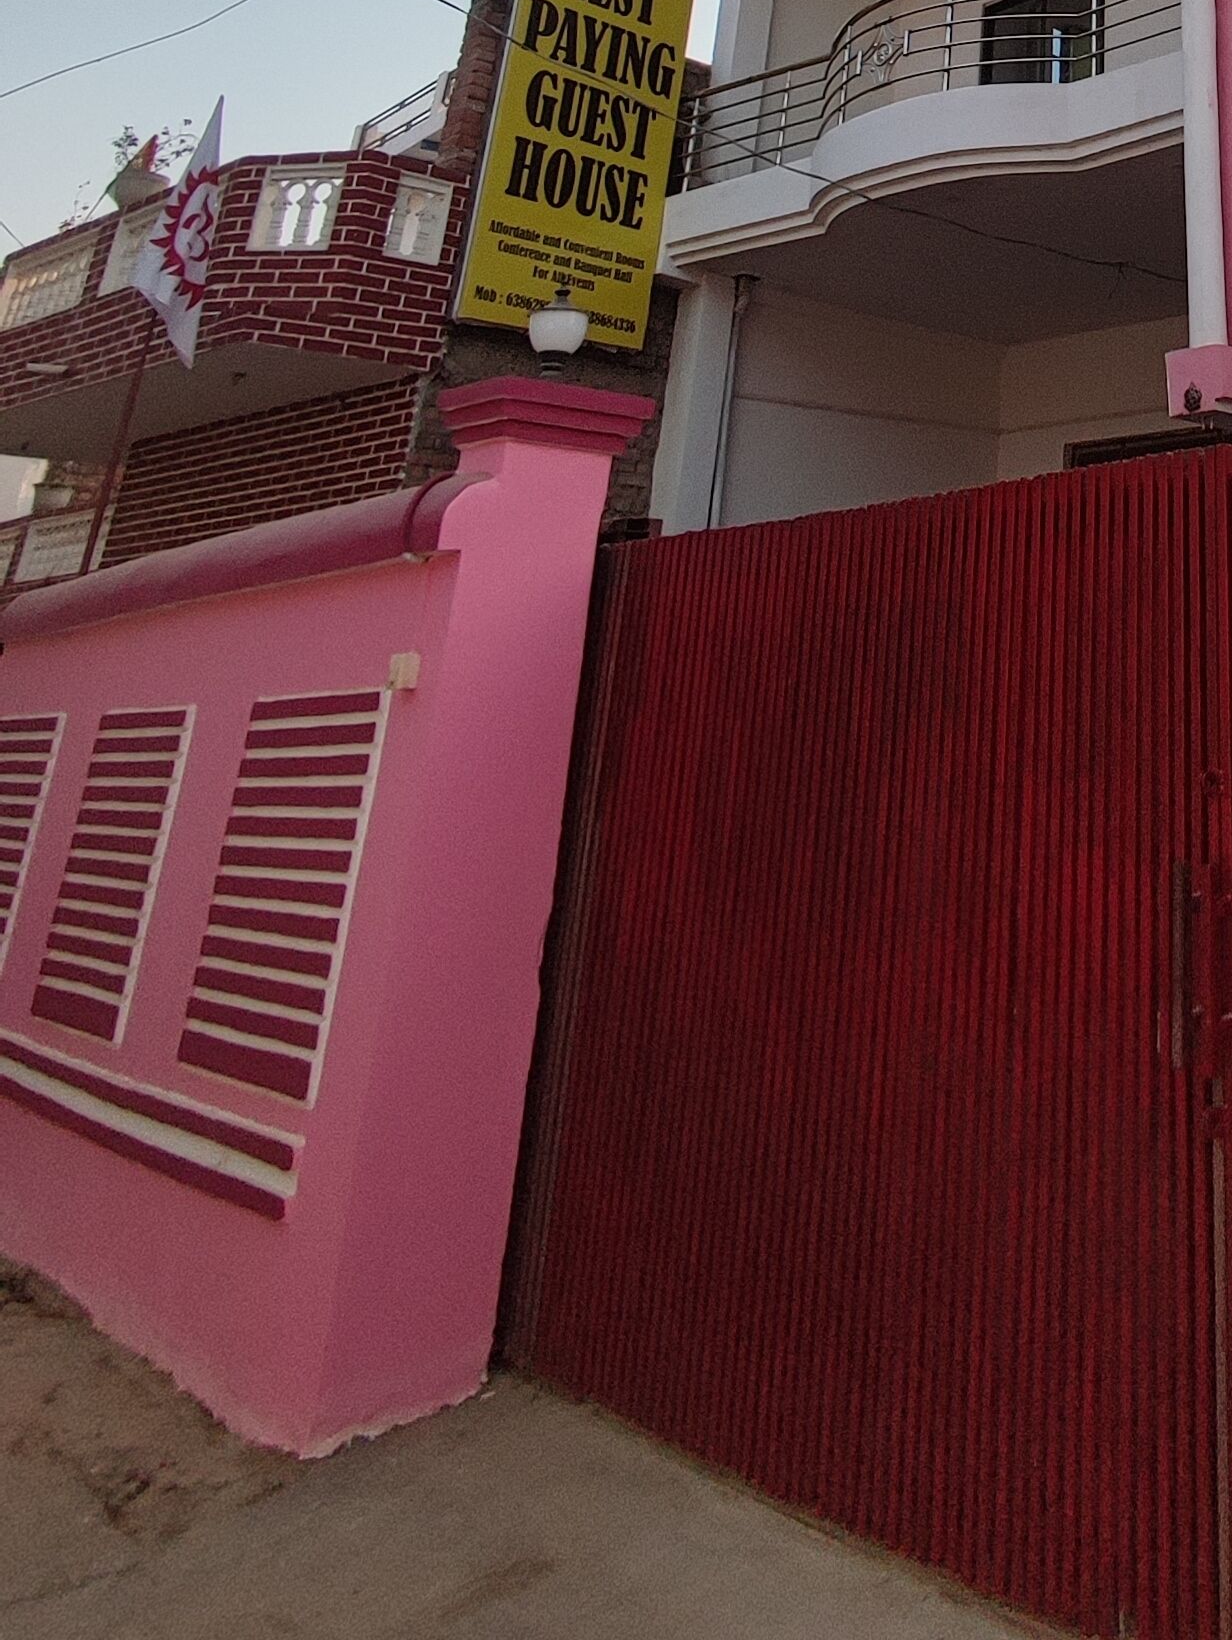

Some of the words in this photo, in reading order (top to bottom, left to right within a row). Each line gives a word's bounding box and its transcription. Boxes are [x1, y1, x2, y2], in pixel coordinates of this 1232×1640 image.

[526, 69, 658, 160] GUEST
[505, 137, 649, 230] HOUSE
[488, 219, 541, 244] Affordable
[543, 234, 562, 249] and
[563, 239, 613, 262] Convenient
[615, 252, 645, 270] Rooms
[498, 239, 551, 264] Conference
[553, 254, 571, 269] and
[573, 258, 612, 279] Banquet
[613, 269, 633, 284] Hall
[474, 285, 497, 303] Mob
[532, 265, 549, 280] For
[564, 273, 595, 292] Events
